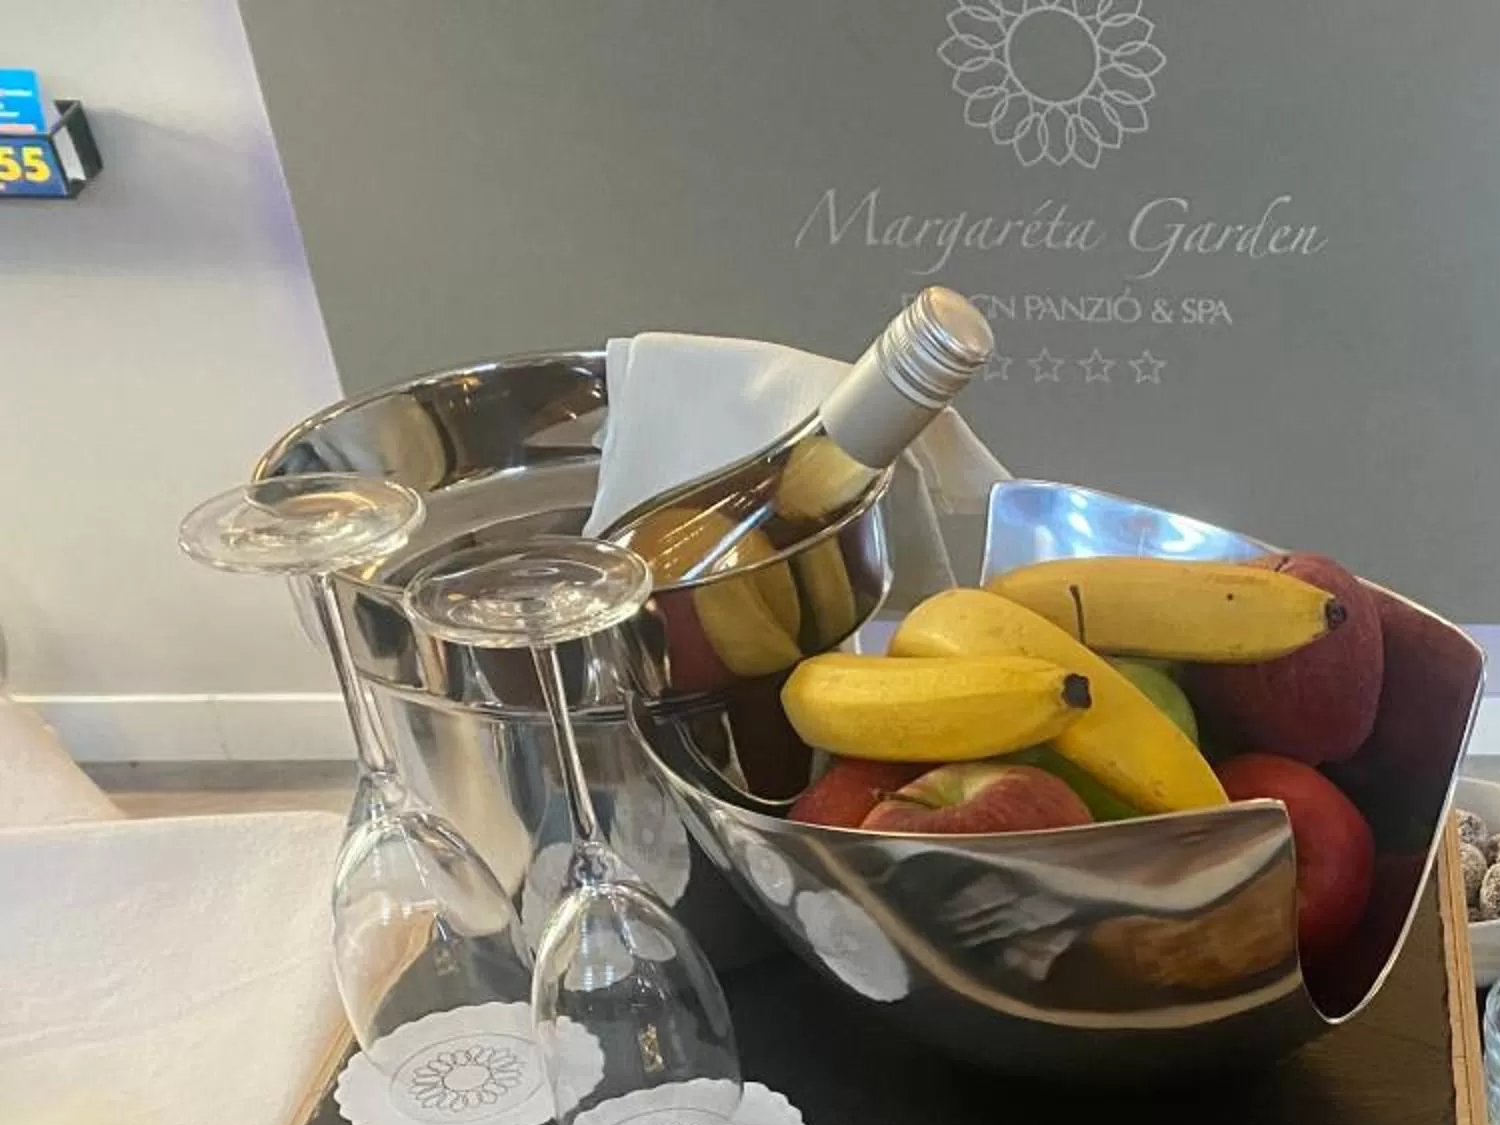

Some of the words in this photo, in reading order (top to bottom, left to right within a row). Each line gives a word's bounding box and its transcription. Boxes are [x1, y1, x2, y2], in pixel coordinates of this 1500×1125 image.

[794, 186, 1101, 276] Margaréta
[1123, 195, 1329, 280] Garden
[1024, 287, 1142, 323] PANZIÓ
[1151, 297, 1173, 324] &
[1181, 297, 1233, 325] SPA
